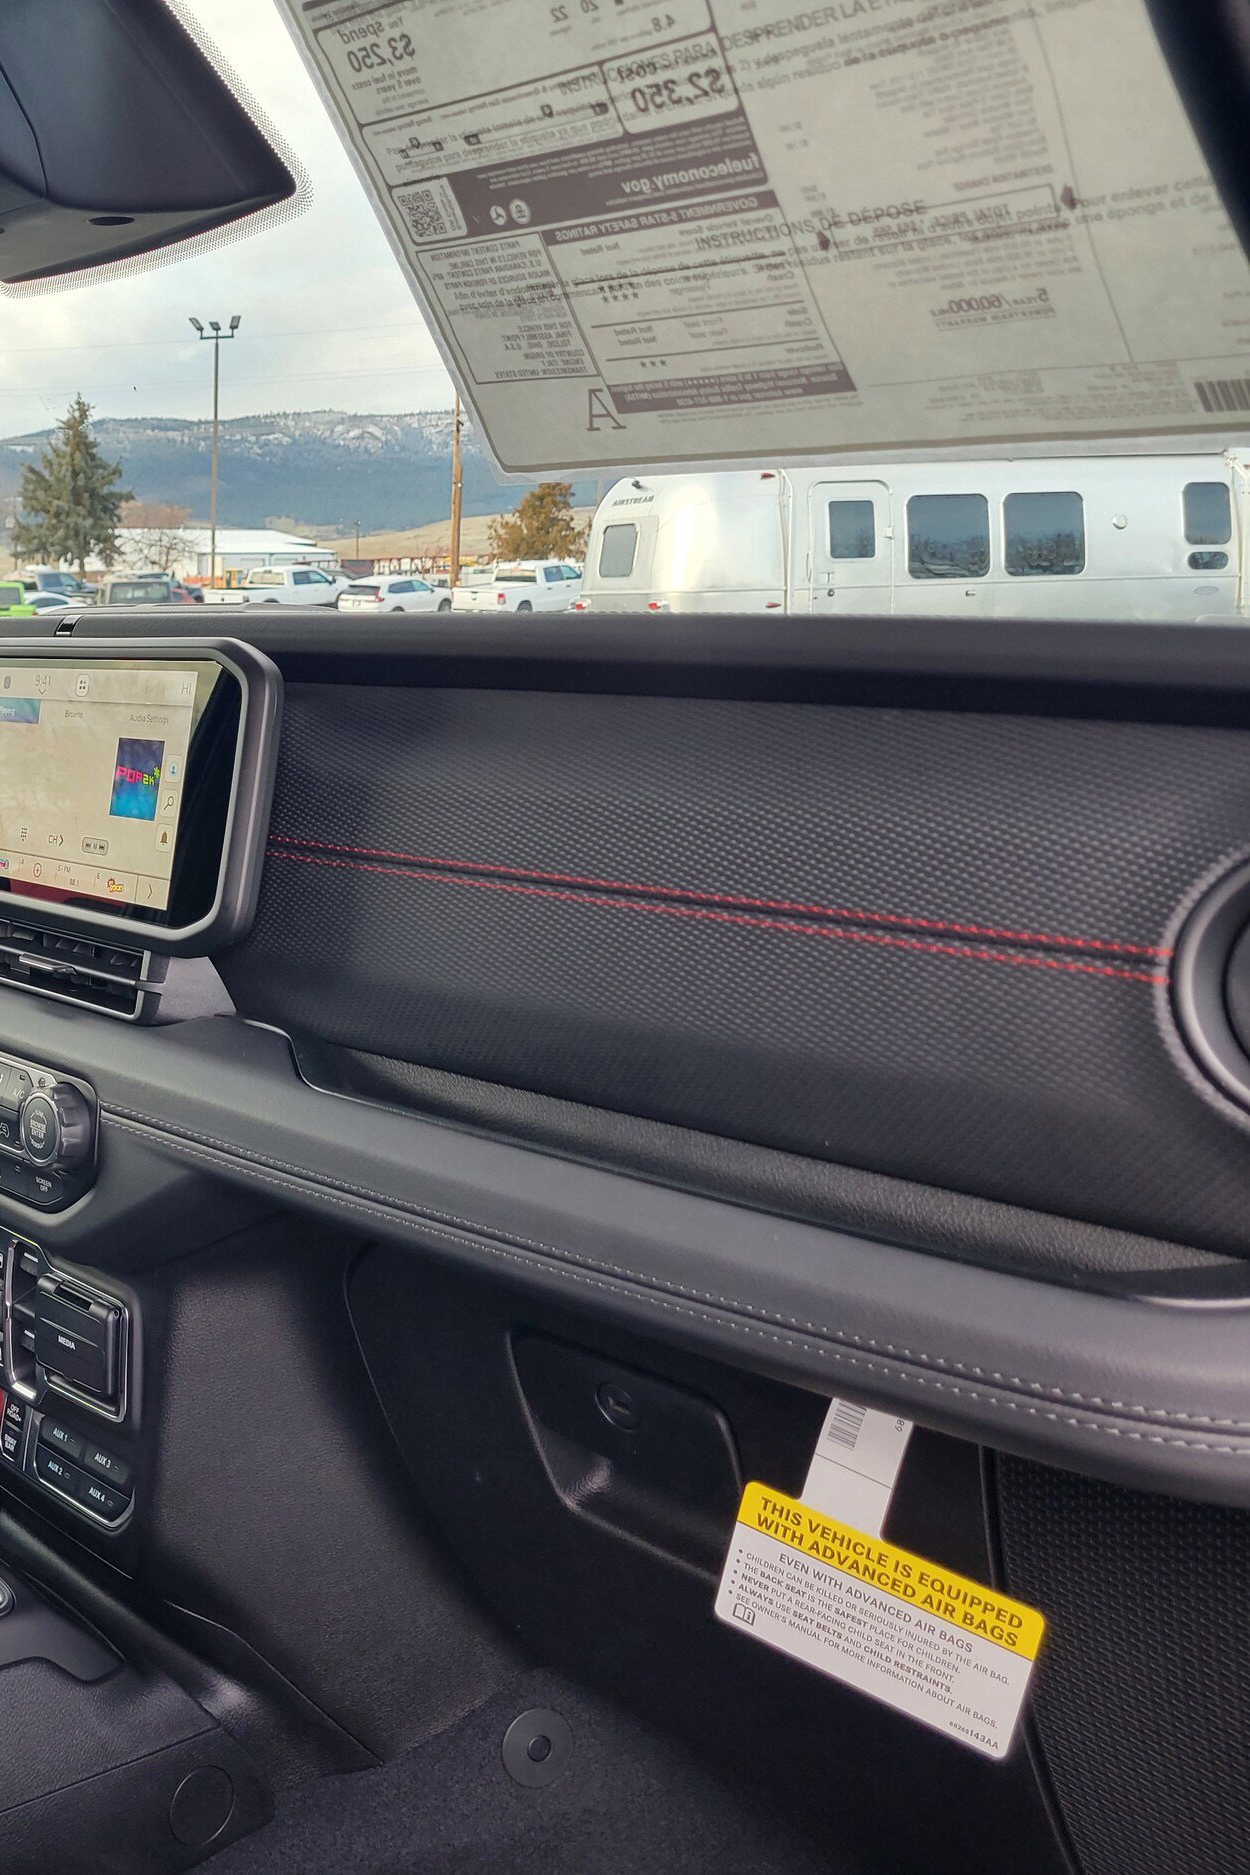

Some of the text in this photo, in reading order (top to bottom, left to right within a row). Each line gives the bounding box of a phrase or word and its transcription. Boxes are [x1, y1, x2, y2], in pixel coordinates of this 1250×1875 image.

[672, 40, 718, 65] PARA
[718, 6, 839, 51] DESPRENDER
[837, 0, 867, 19] LA
[693, 218, 816, 251] INSTRUCTIONS
[816, 213, 845, 231] DE
[612, 495, 655, 507] AIRSTREAM
[12, 1088, 24, 1099] A/C
[30, 1121, 46, 1132] BROWSE
[31, 1129, 44, 1139] ENTER
[35, 1176, 52, 1188] SCREEN
[40, 1184, 48, 1192] OFF
[58, 1334, 76, 1350] MEDIA
[10, 1404, 20, 1414] OFF
[52, 1427, 64, 1441] AUX
[5, 1441, 15, 1452] BAR
[48, 1460, 58, 1474] AUX
[94, 1453, 107, 1467] AUX
[89, 1486, 100, 1501] AUX
[759, 1496, 1023, 1630] THIS VEHICLE IS EQUIPPED
[755, 1513, 1018, 1647] WITH ADVANCED AIR BAGS
[779, 1552, 973, 1653] EVEN WITH ADVANCED AIR BAGS
[743, 1562, 961, 1673] THE BACK SEAT IS THE SAFEST PLACE FOR CHILDREN.
[746, 1552, 1010, 1685] CHILDREN CAN BE KILLED OR SERIOUSLY INJURED BY THE AIR BAG.
[741, 1572, 955, 1683] NEVER PUT A REAR-FACING CHILD SEAT IN THE FRONT.
[738, 1582, 953, 1694] ALWAYS USE SEAT BELTS AND CHILD RESTRAINTS.
[735, 1592, 998, 1729] SEE OWNER'S MANUAL FOR MORE INFORMATION ABOUT AIR BAGS.
